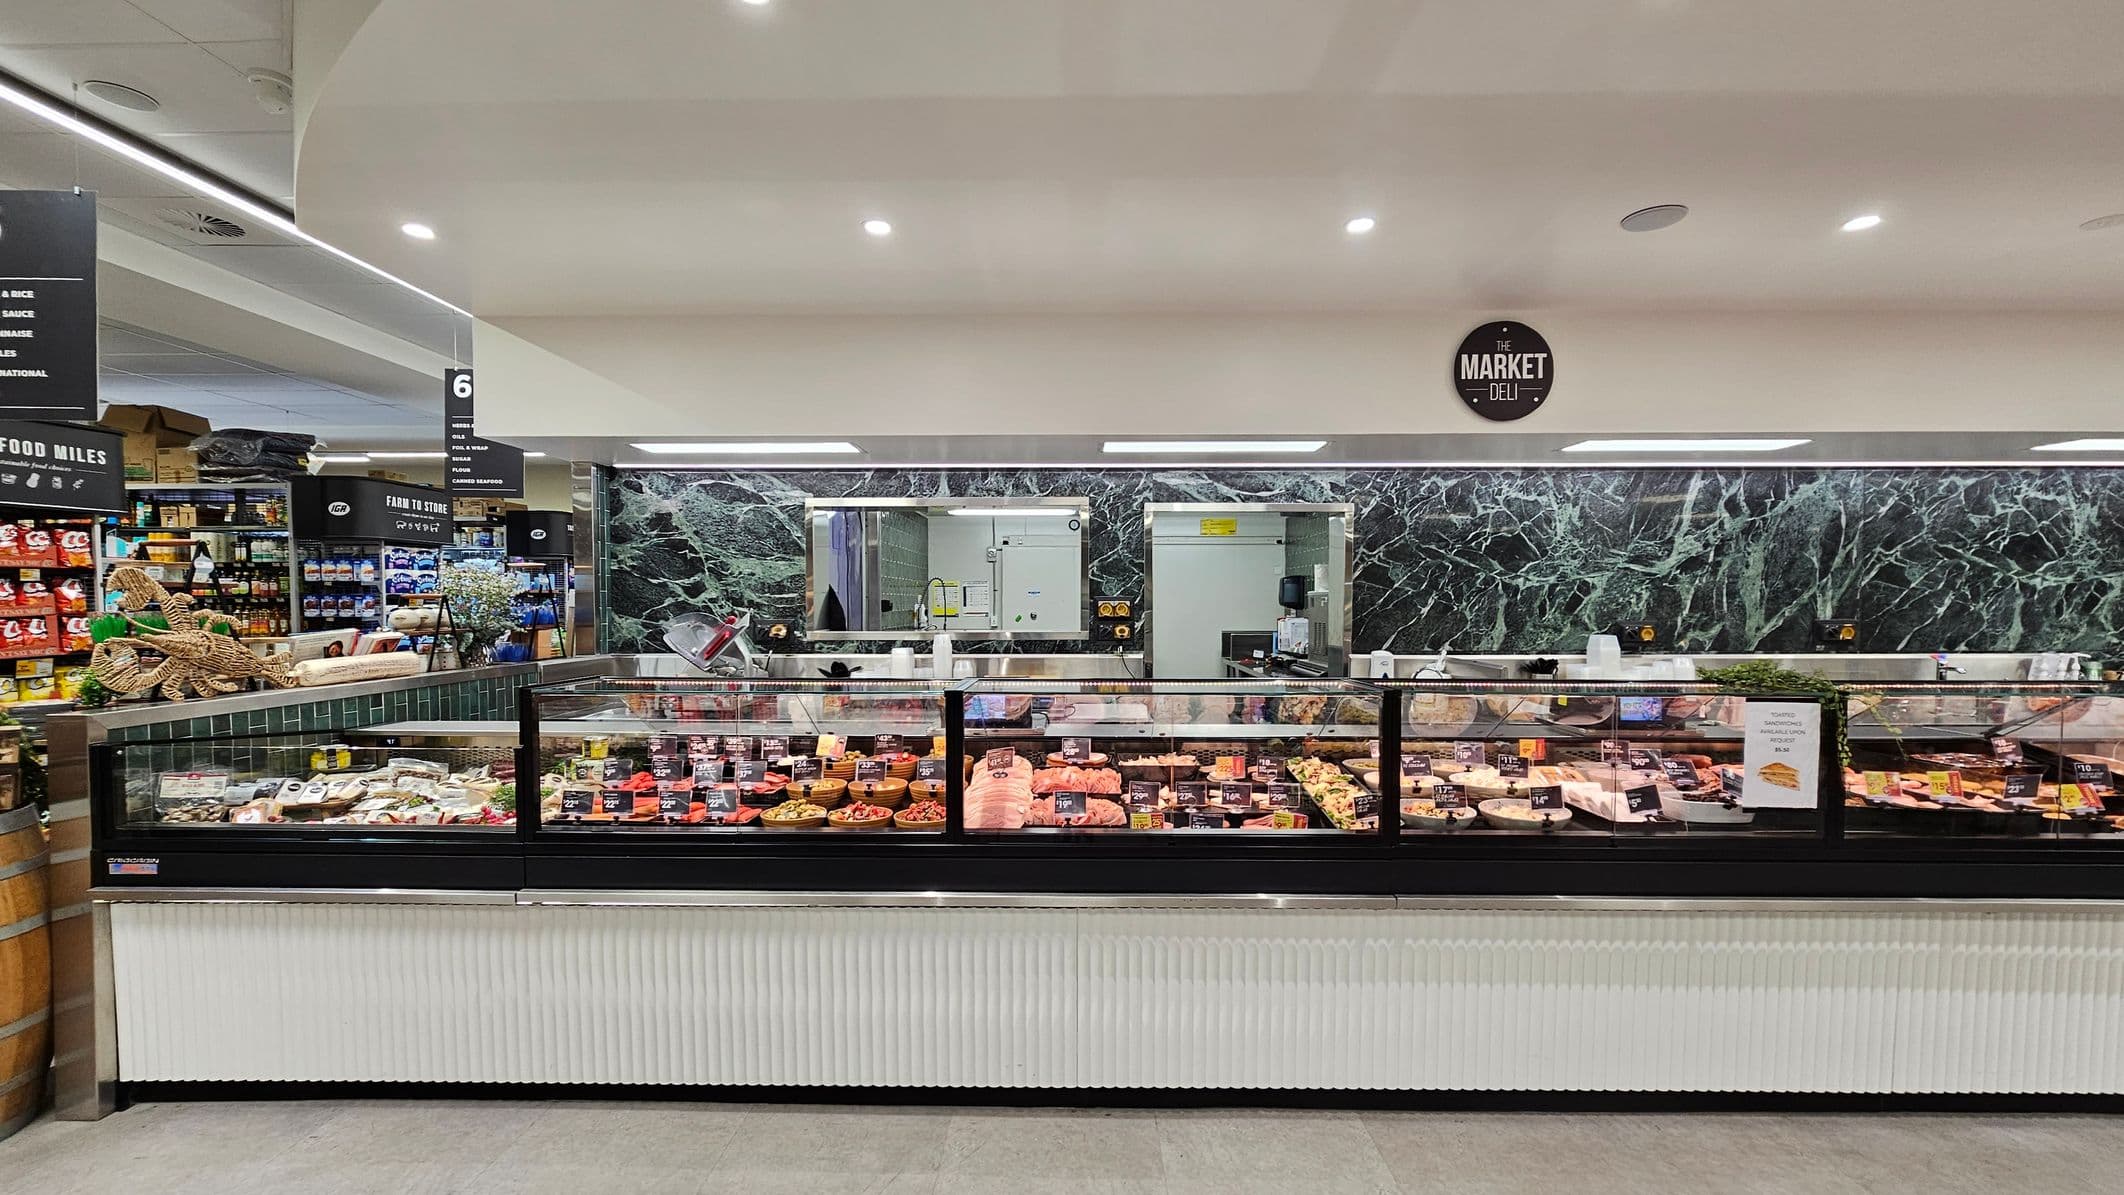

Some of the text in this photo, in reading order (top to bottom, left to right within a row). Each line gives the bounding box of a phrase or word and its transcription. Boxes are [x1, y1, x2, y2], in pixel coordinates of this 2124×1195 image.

[1, 290, 35, 299] & RICE
[2, 310, 35, 318] SAUCE
[1496, 340, 1511, 351] THE
[1461, 353, 1547, 380] MARKET
[452, 374, 472, 399] 6
[1490, 382, 1518, 401] DELI
[0, 436, 106, 465] FOOD MILES
[331, 504, 347, 513] IGA
[386, 495, 448, 515] FARM TO STORE
